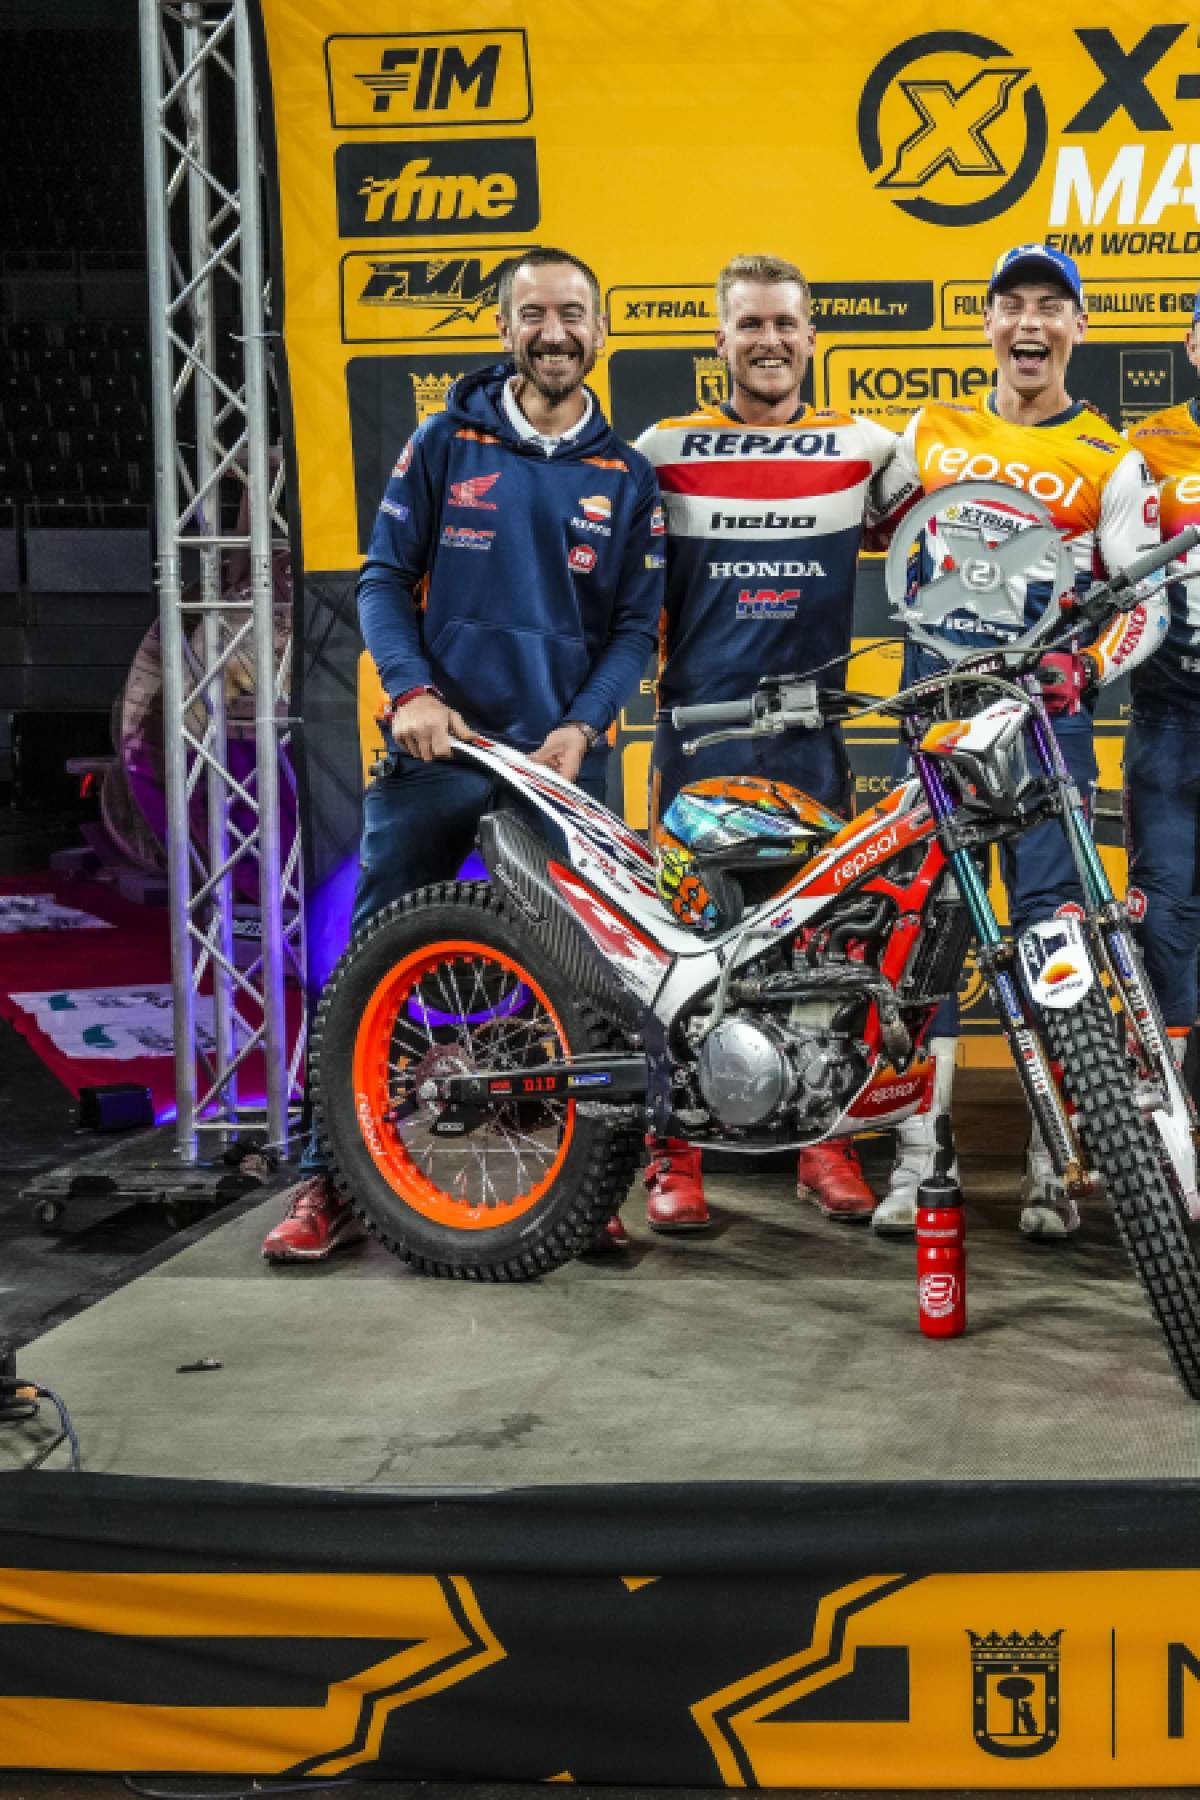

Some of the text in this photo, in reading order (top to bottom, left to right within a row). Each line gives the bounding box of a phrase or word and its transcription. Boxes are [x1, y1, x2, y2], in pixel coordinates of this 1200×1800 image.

[354, 44, 502, 113] FIM
[357, 157, 518, 223] rfme
[1046, 233, 1094, 257] FIM
[680, 431, 841, 458] REPSOL
[924, 442, 1084, 508] repsol
[711, 511, 817, 531] hebo
[708, 561, 827, 580] HONDA
[736, 590, 801, 614] HRC
[833, 826, 899, 886] repsol
